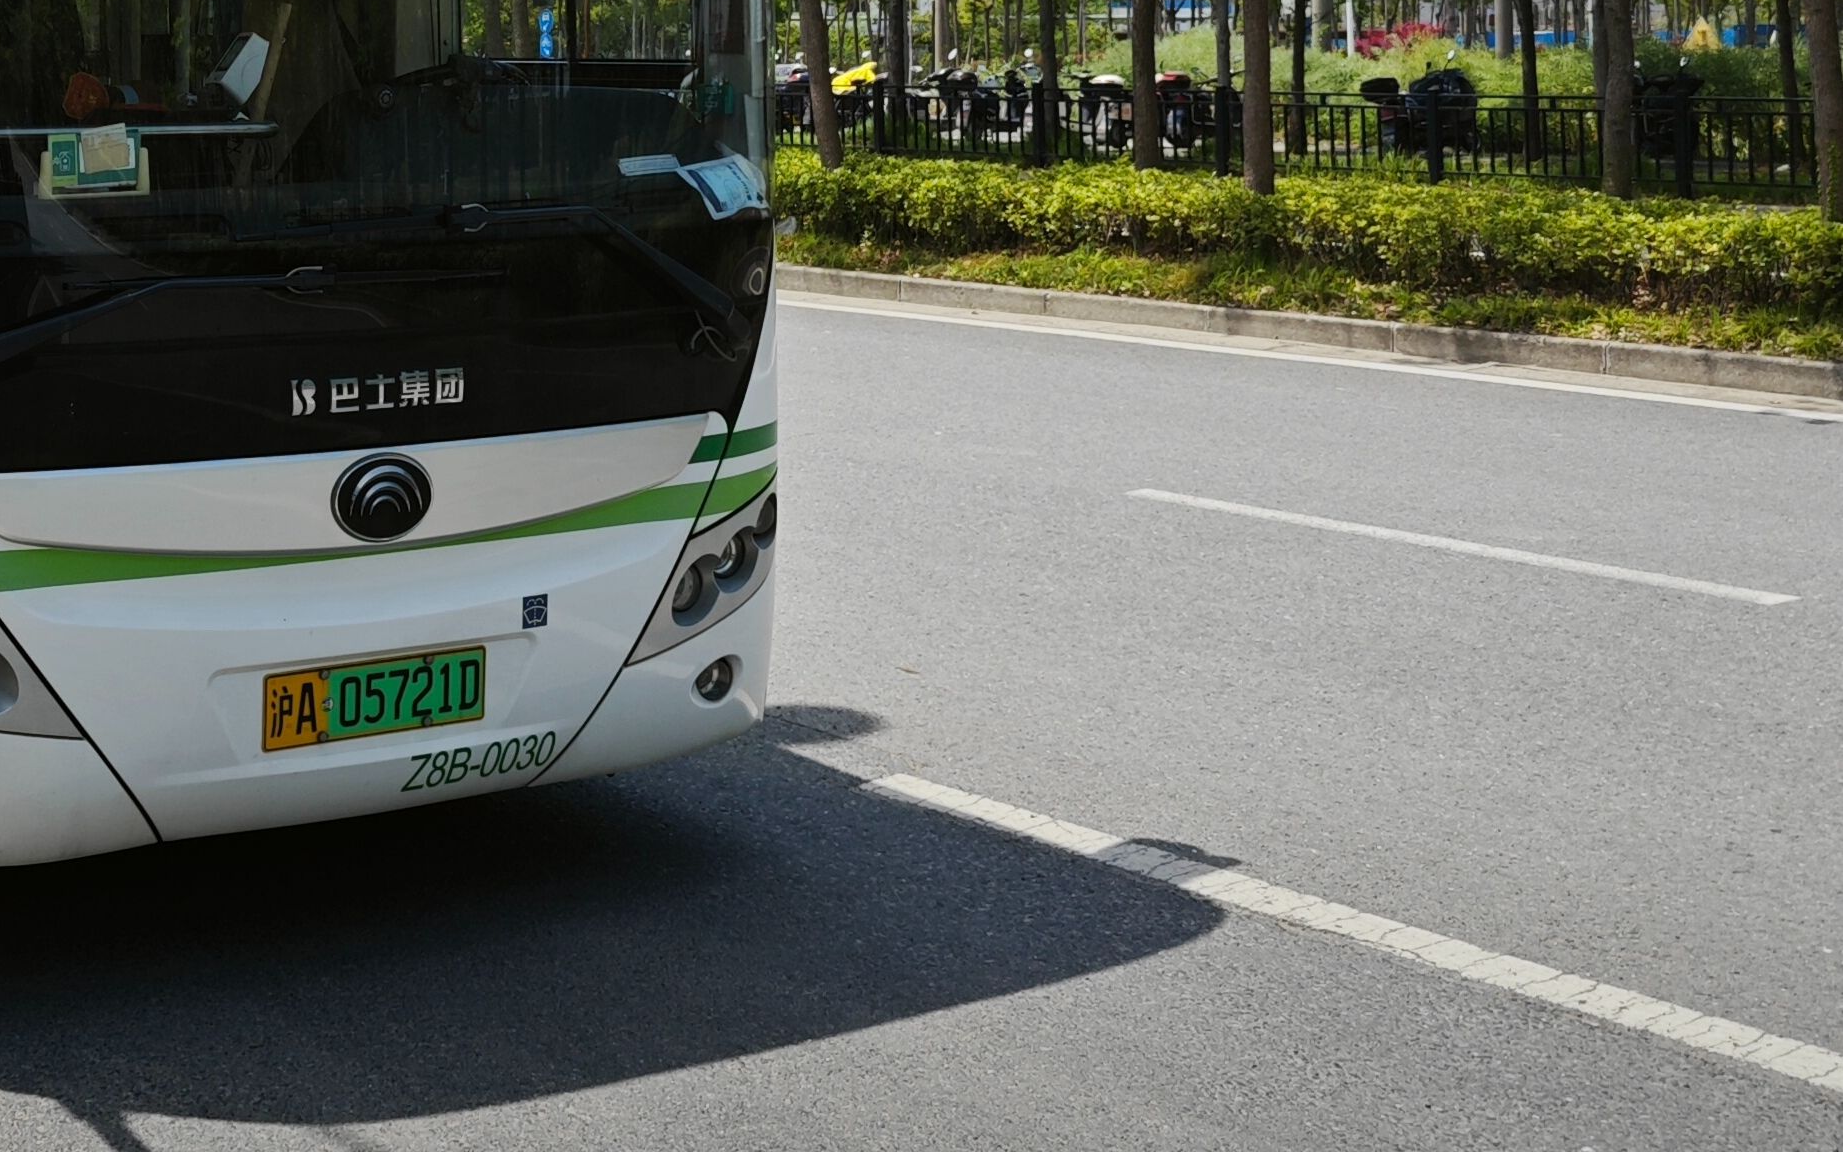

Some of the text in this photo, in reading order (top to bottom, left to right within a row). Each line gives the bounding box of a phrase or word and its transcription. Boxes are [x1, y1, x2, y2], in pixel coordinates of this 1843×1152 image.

[329, 367, 465, 414] 巴士集团
[270, 659, 480, 739] 沪A 05721D
[400, 730, 556, 793] Z8B-0030
